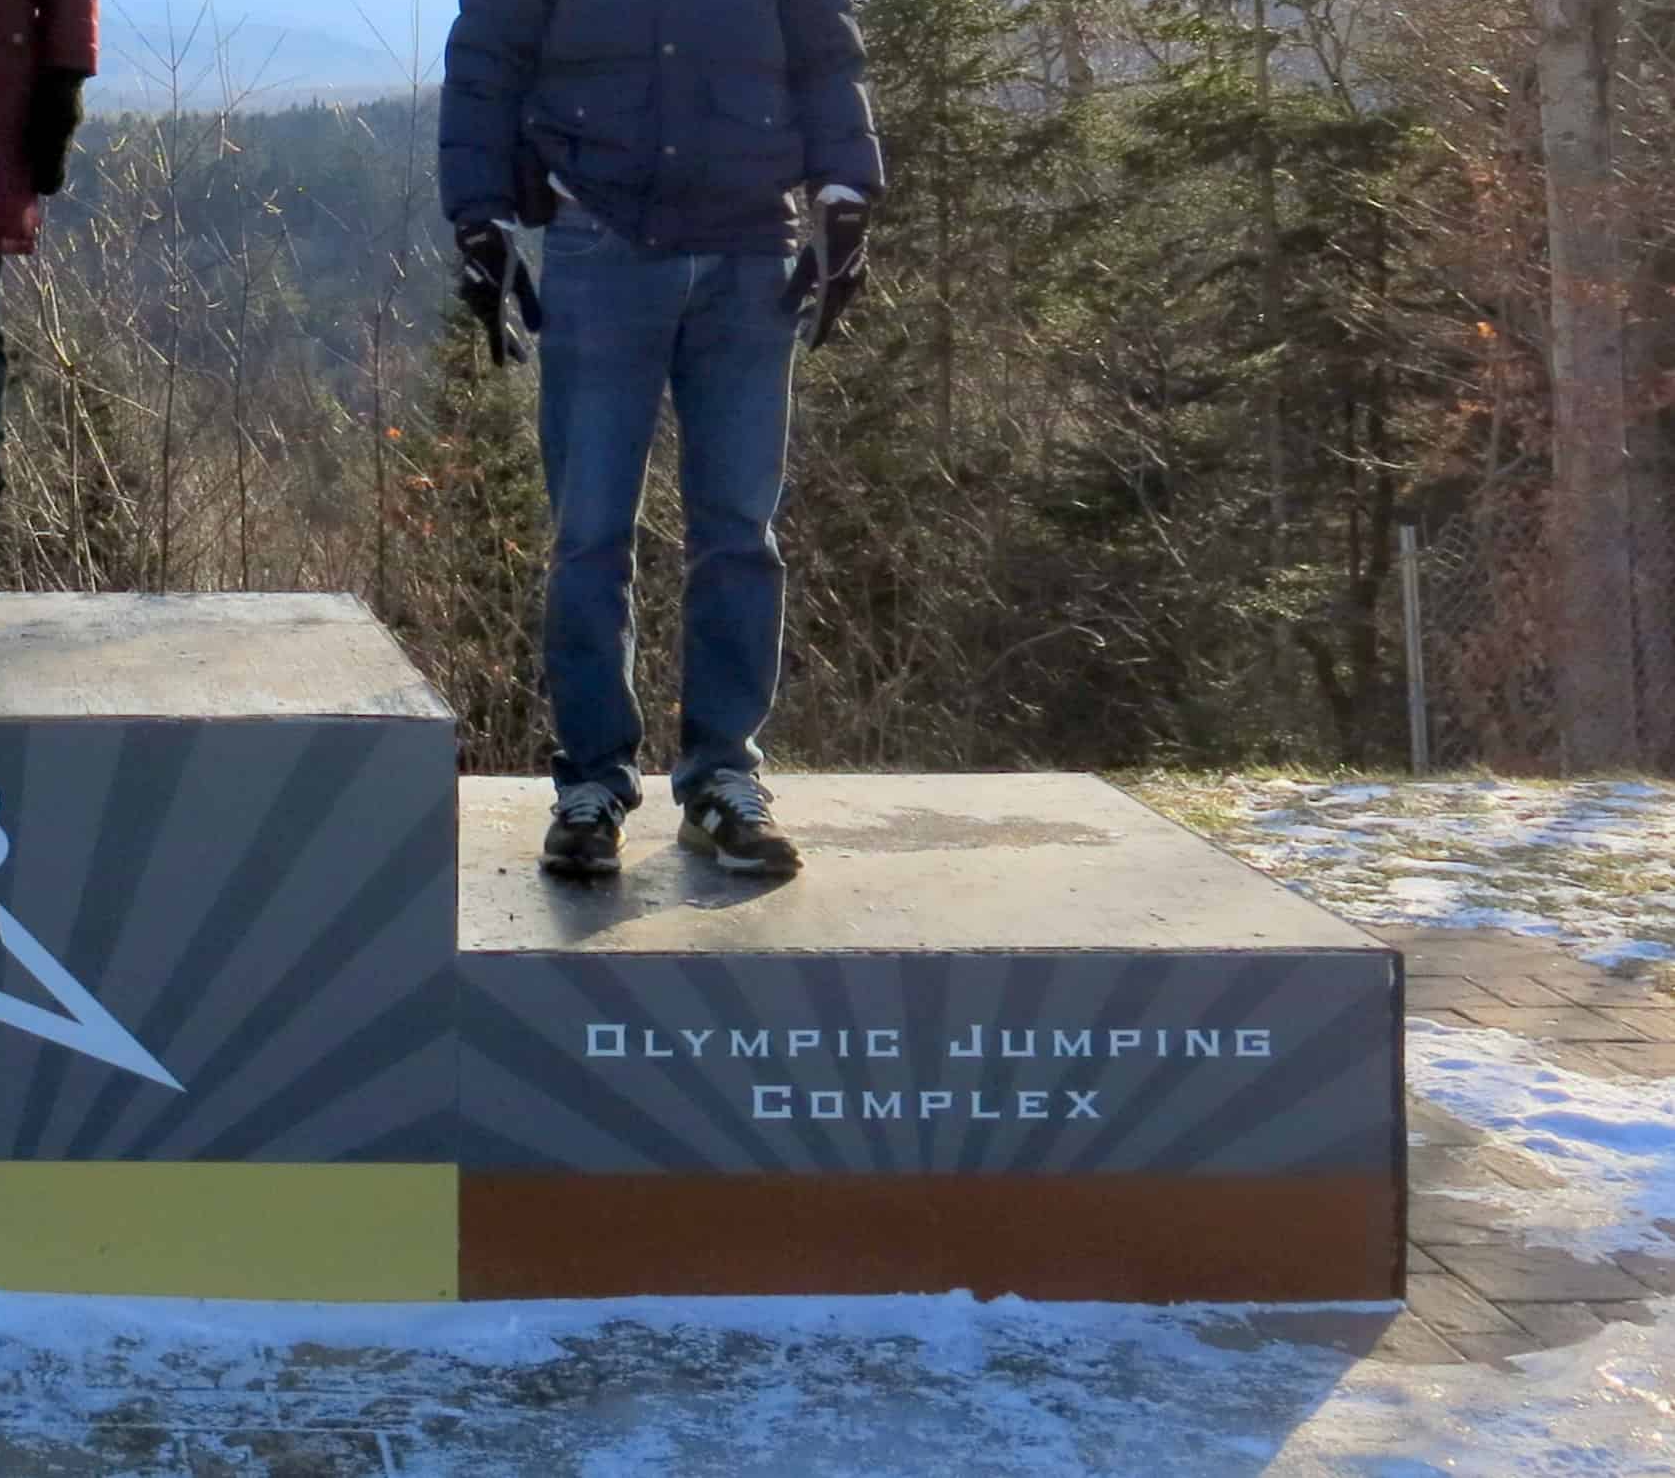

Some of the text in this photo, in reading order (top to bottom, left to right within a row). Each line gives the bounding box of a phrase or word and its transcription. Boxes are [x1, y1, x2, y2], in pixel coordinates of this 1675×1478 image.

[586, 1023, 1271, 1058] OLYMPIC JUMPING
[752, 1085, 1101, 1119] COMPLEX
